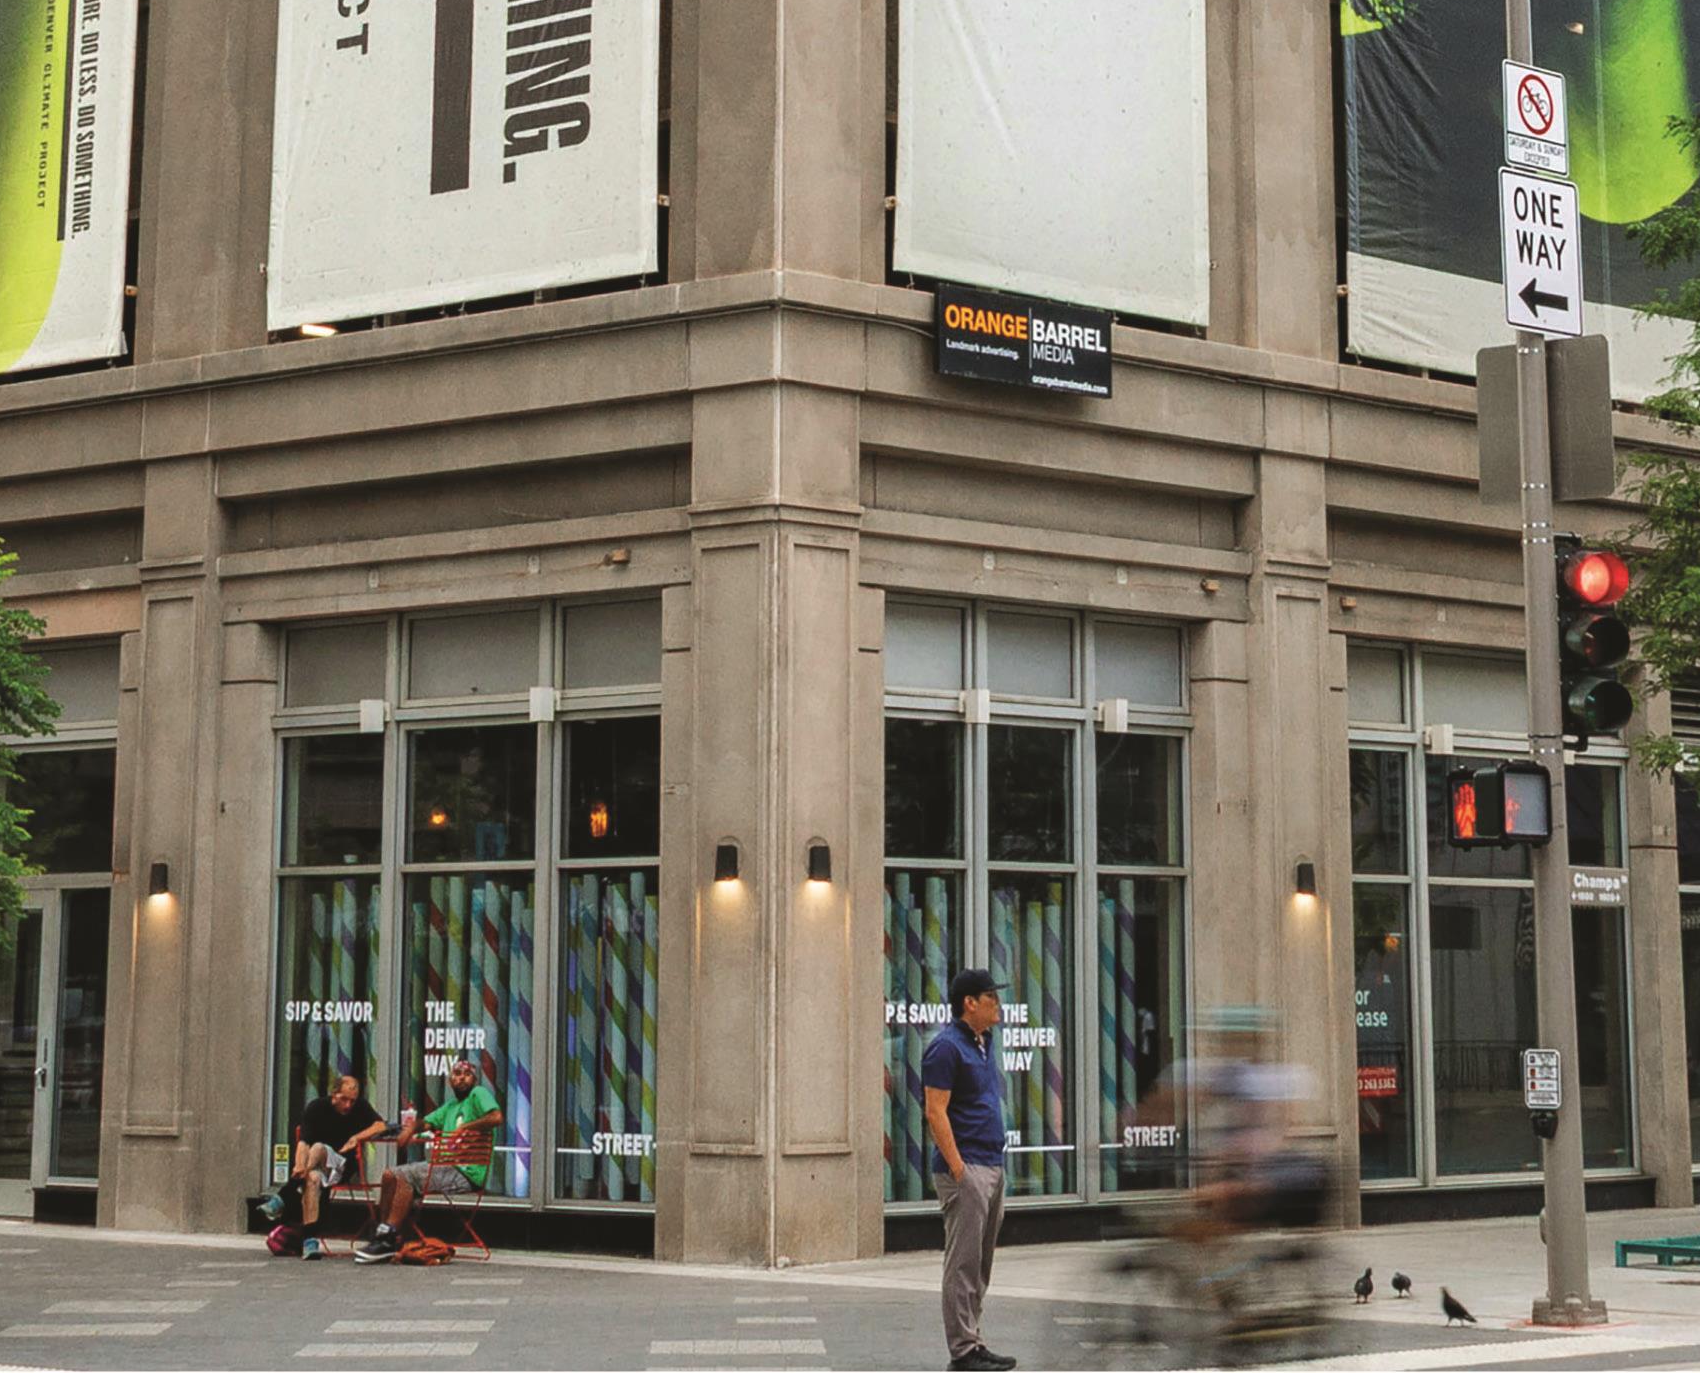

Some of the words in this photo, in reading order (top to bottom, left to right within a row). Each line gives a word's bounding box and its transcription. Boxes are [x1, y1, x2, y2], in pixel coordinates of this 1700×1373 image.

[80, 30, 99, 57] DO
[78, 56, 98, 104] LESS.
[40, 62, 52, 131] CLIMATE
[77, 104, 96, 130] DO
[37, 141, 49, 208] PROJECT
[71, 129, 95, 239] SOMETHING.
[1514, 187, 1563, 228] ONE
[1516, 229, 1566, 271] WAY
[945, 304, 1028, 340] ORANGE
[1032, 319, 1108, 353] BARREL
[946, 338, 980, 354] Landmark
[1032, 344, 1075, 365] MEDIA
[1574, 873, 1620, 891] Champa
[1355, 990, 1371, 1005] or
[285, 1001, 311, 1021] SIP
[312, 1002, 322, 1021] &
[324, 1001, 373, 1022] SAVOR
[425, 1001, 455, 1022] THE
[896, 1004, 907, 1023] &
[1002, 1004, 1028, 1023] THE
[1357, 1011, 1388, 1027] ease
[425, 1029, 486, 1049] DENVER
[1002, 1028, 1055, 1047] DENVER
[424, 1055, 460, 1076] WAY
[1002, 1052, 1033, 1071] WAY
[592, 1132, 653, 1155] STREET
[1006, 1130, 1021, 1146] TH
[1124, 1126, 1176, 1147] STREET
